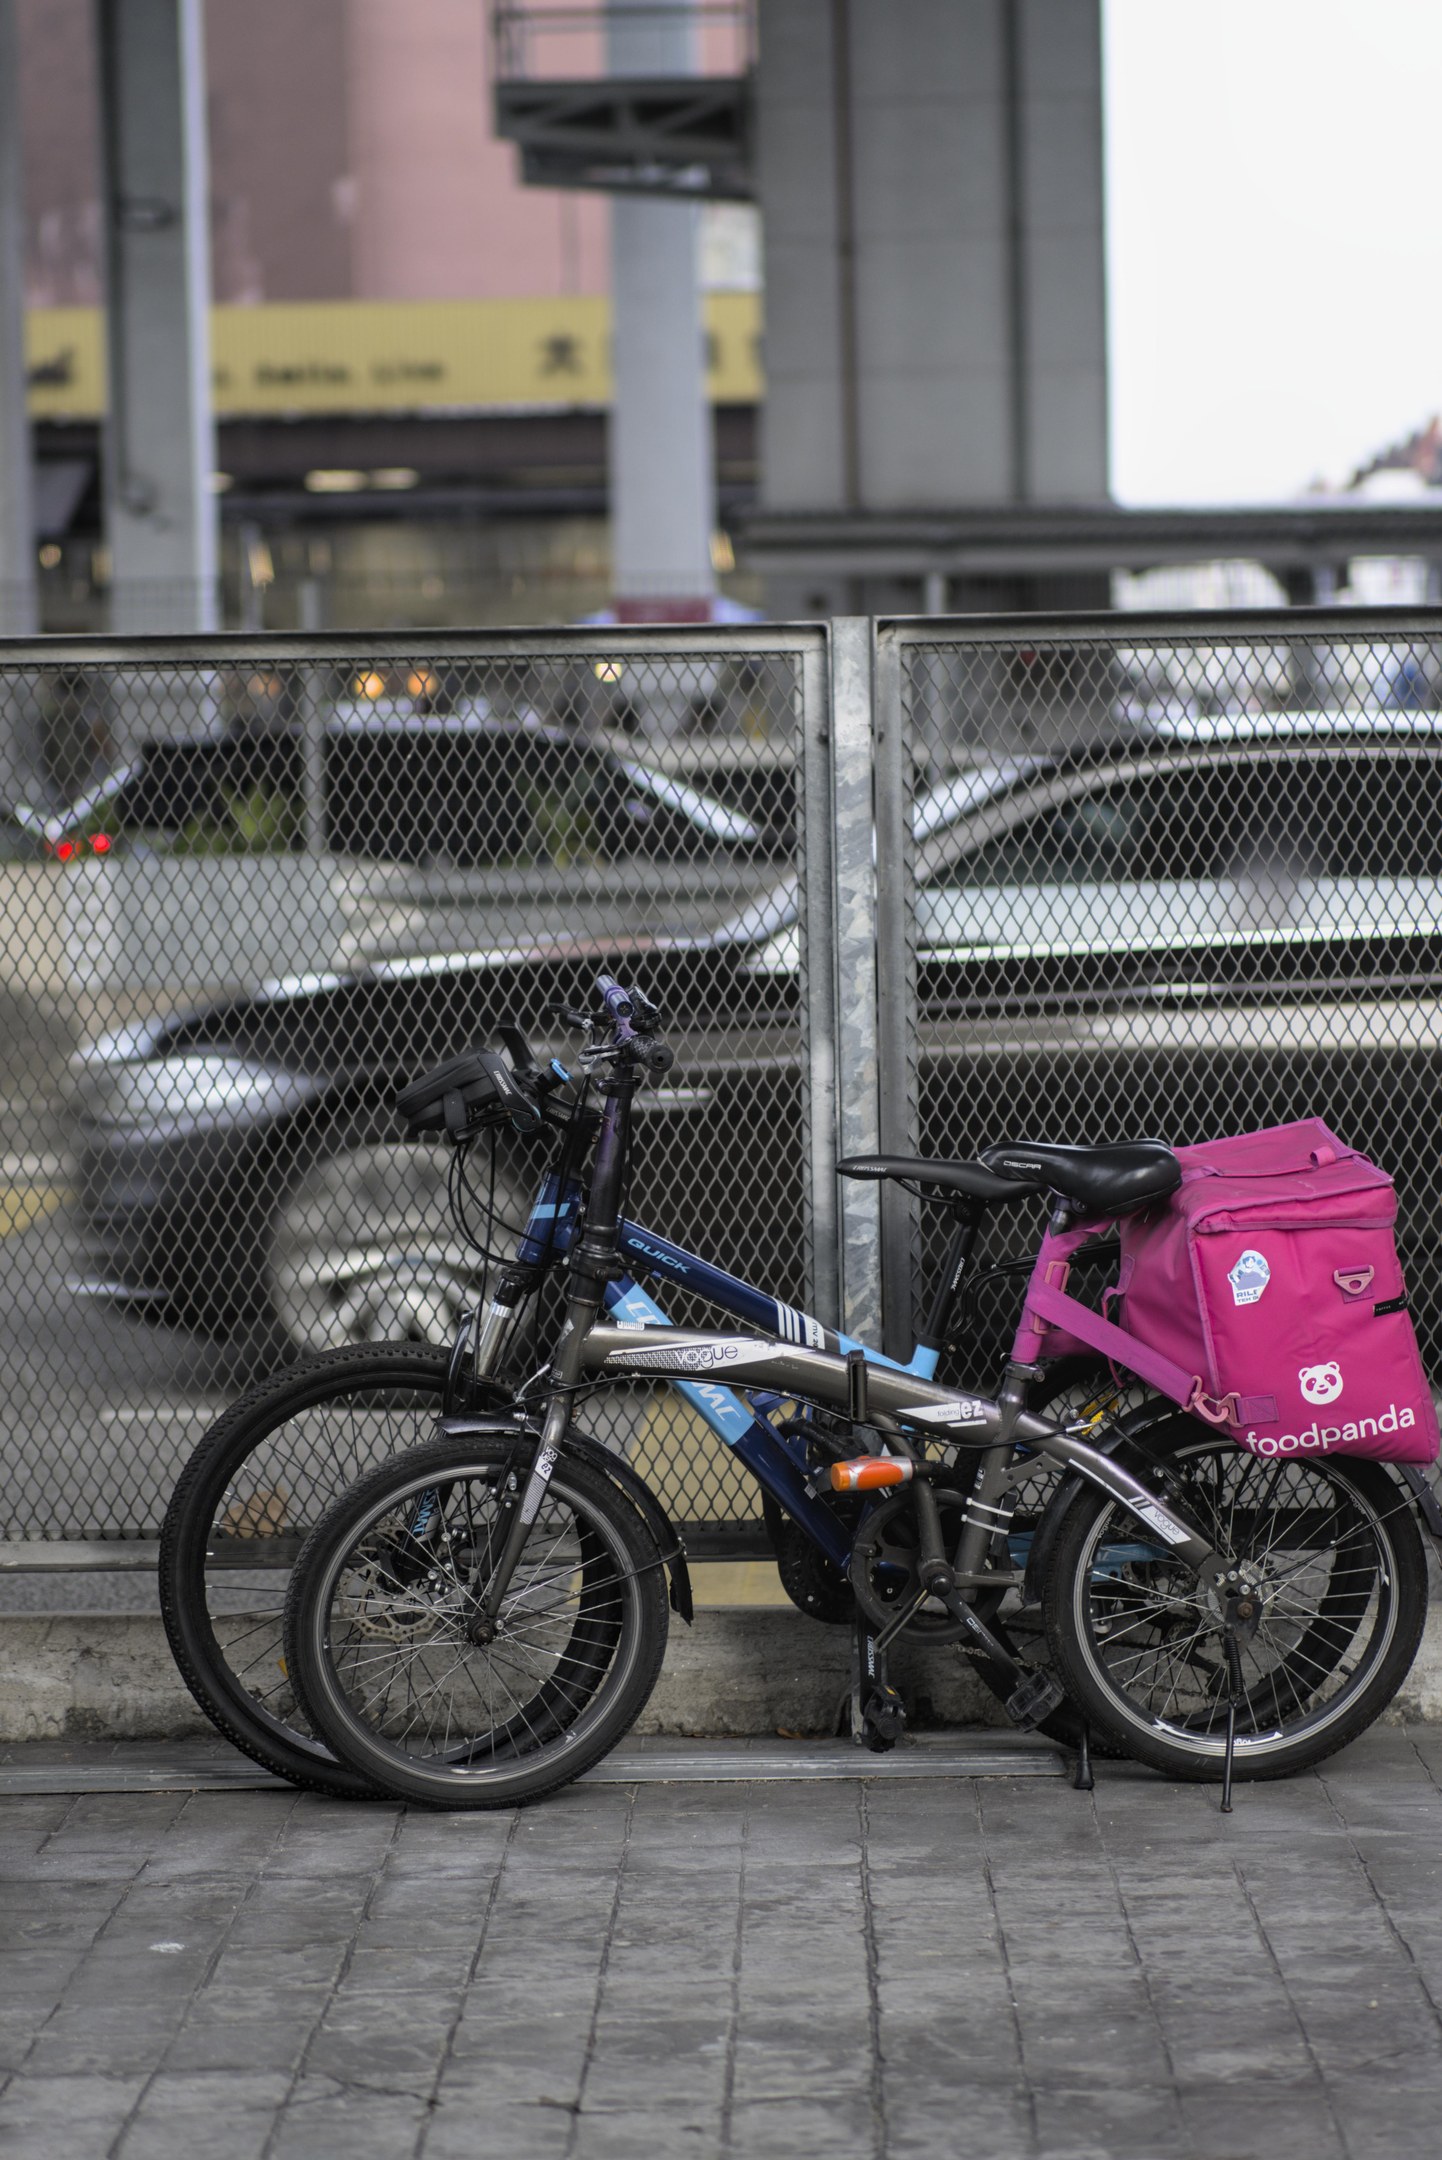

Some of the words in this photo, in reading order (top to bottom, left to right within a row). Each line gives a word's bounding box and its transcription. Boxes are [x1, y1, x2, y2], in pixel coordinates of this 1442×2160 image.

[627, 1238, 691, 1274] QUICK
[674, 1345, 738, 1369] vogue
[937, 1408, 960, 1417] folding
[960, 1400, 984, 1419] ez
[1245, 1404, 1416, 1456] foodpanda
[1154, 1511, 1180, 1535] vogue
